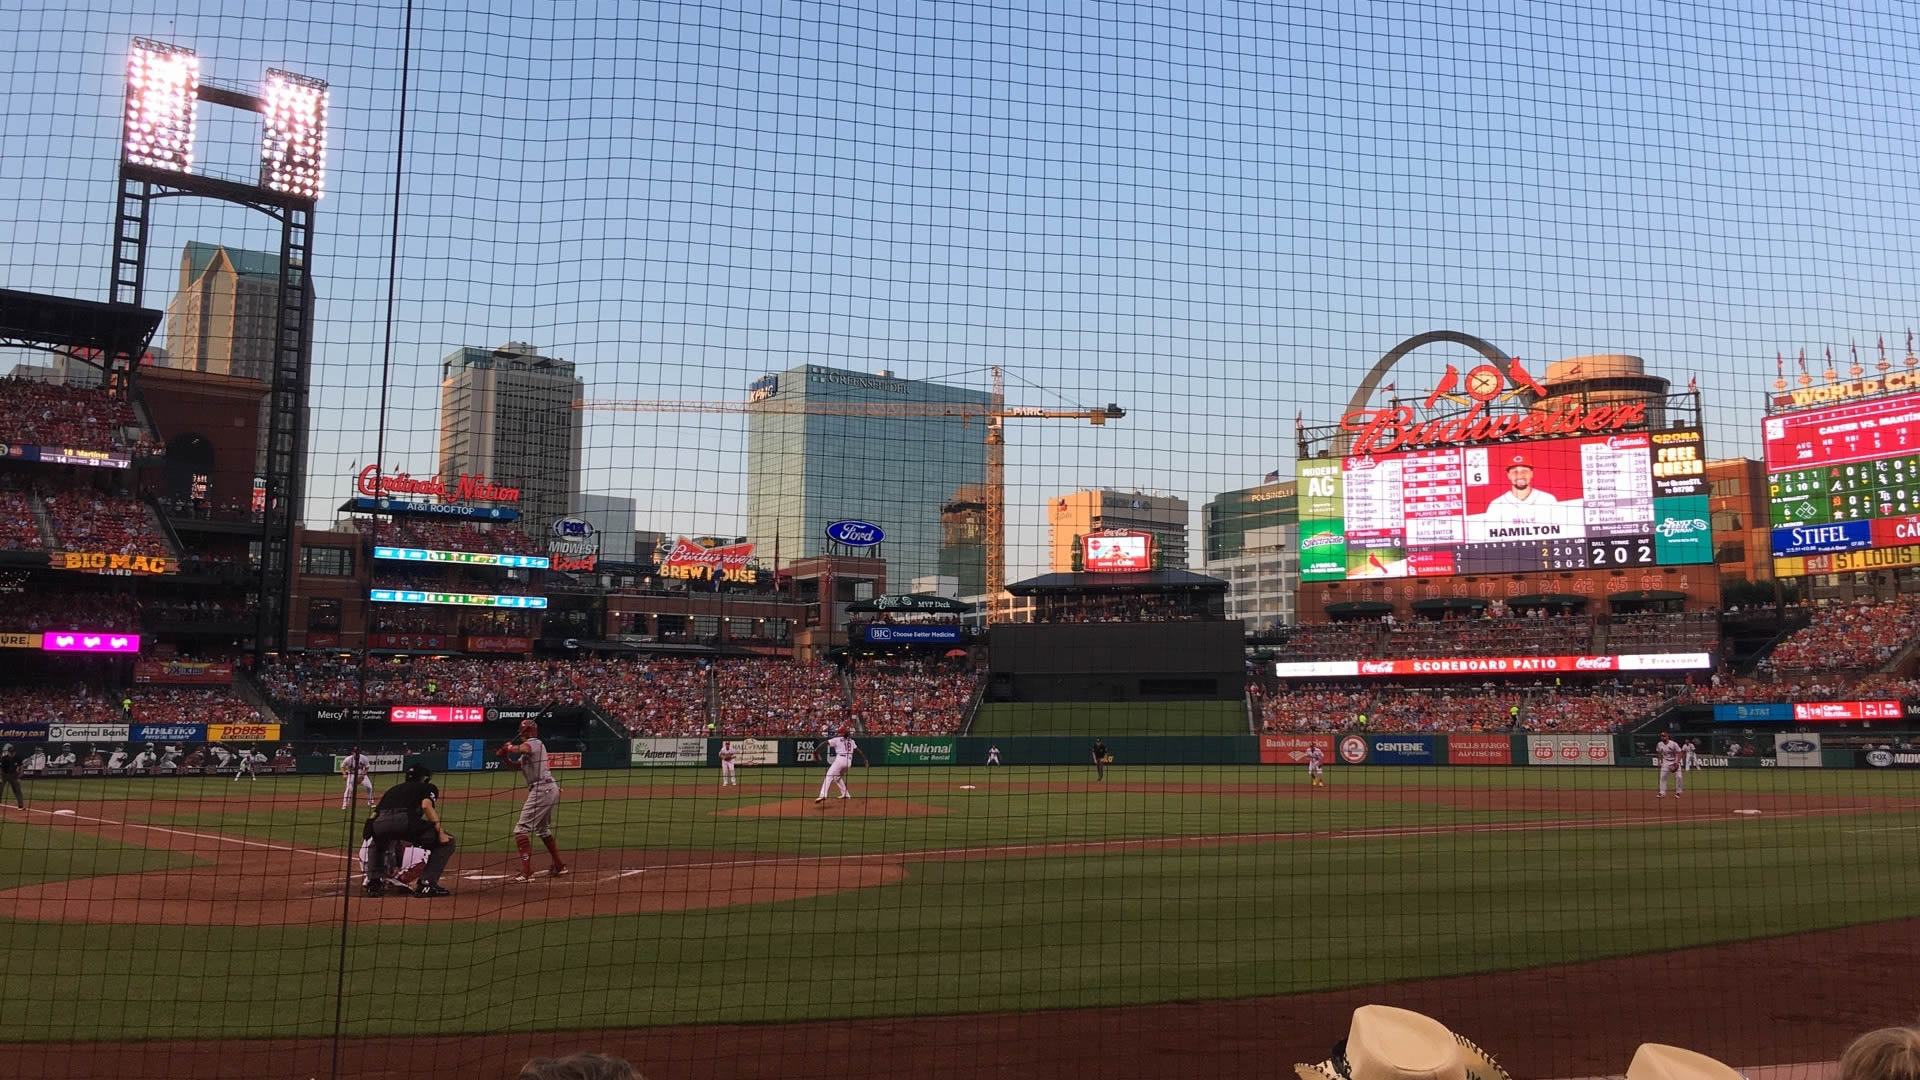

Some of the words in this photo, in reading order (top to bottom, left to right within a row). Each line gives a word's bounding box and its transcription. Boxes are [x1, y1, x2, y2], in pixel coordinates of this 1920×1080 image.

[750, 384, 774, 402] KPMG
[1791, 381, 1879, 406] WORLD
[1341, 397, 1647, 455] Budweiser
[1874, 440, 1880, 448] 5
[1658, 446, 1697, 463] FREE
[1894, 460, 1902, 470] 0
[1846, 466, 1854, 476] 0
[1474, 473, 1482, 482] 6
[1784, 474, 1791, 482] 2
[1798, 472, 1805, 480] 3
[1895, 473, 1903, 482] 3
[358, 464, 446, 497] Cardinals
[447, 472, 520, 502] Nation
[1308, 476, 1335, 497] AG
[1770, 485, 1780, 497] P
[1785, 485, 1792, 493] 6
[1797, 482, 1808, 491] 10
[1812, 481, 1820, 489] 0
[1897, 490, 1905, 499] 0
[1848, 495, 1856, 505] 0
[407, 502, 428, 511] AT&T
[430, 503, 475, 515] ROOFTOP
[1784, 508, 1791, 516] 6
[1898, 503, 1906, 512] 4
[1850, 508, 1858, 518] 2
[563, 521, 586, 532] FOX
[1489, 525, 1560, 538] HAMILTON
[1642, 523, 1650, 533] 6
[840, 523, 874, 542] Ford
[1792, 526, 1849, 546] STIFEL
[549, 541, 599, 554] MIDWEST
[1394, 538, 1401, 547] 6
[1456, 553, 1461, 561] 2
[1541, 548, 1549, 557] 2
[1553, 547, 1561, 556] 2
[1565, 547, 1572, 555] 0
[1578, 547, 1583, 555] 1
[1592, 548, 1607, 564] 2
[1614, 547, 1628, 563] 0
[1638, 546, 1652, 562] 2
[1864, 546, 1913, 566] LOUIS
[64, 552, 106, 569] BIG
[110, 554, 166, 574] MAC
[1418, 564, 1452, 572] CARDINALS
[1544, 561, 1549, 569] 1
[1554, 560, 1561, 569] 3
[1565, 559, 1573, 568] 0
[1578, 559, 1585, 567] 2
[99, 568, 132, 576] LAND
[659, 564, 704, 579] BREW
[1404, 586, 1414, 600] 9
[1426, 585, 1441, 599] 10
[1453, 583, 1467, 598] 14
[1480, 582, 1496, 598] 17
[1507, 581, 1529, 596] 20
[1540, 580, 1561, 594] 24
[1573, 578, 1595, 593] 42
[1607, 576, 1629, 592] 45
[1641, 575, 1664, 590] 85
[873, 629, 889, 638] BJC
[1362, 661, 1395, 673] Coca-Cola
[1413, 658, 1507, 672] SCOREBOARD
[1513, 658, 1557, 669] PATIO
[1576, 656, 1612, 669] Coca-Cola
[317, 710, 344, 720] Mercy
[500, 711, 525, 719] JIMMY
[66, 727, 101, 737] Central
[103, 727, 128, 737] Bank
[141, 726, 197, 735] ATHLETICO
[222, 725, 267, 735] DOBBS
[797, 741, 815, 750] FOX
[902, 742, 952, 754] National
[1266, 738, 1286, 748] Bank
[1287, 738, 1295, 748] of
[1376, 742, 1424, 752] CENTENE
[1787, 742, 1809, 752] Ford
[644, 749, 676, 759] Ameren
[1347, 740, 1359, 758] 2
[1536, 749, 1551, 758] 66
[1563, 749, 1578, 757] 66
[1591, 748, 1605, 757] 66
[1872, 753, 1887, 761] FOX
